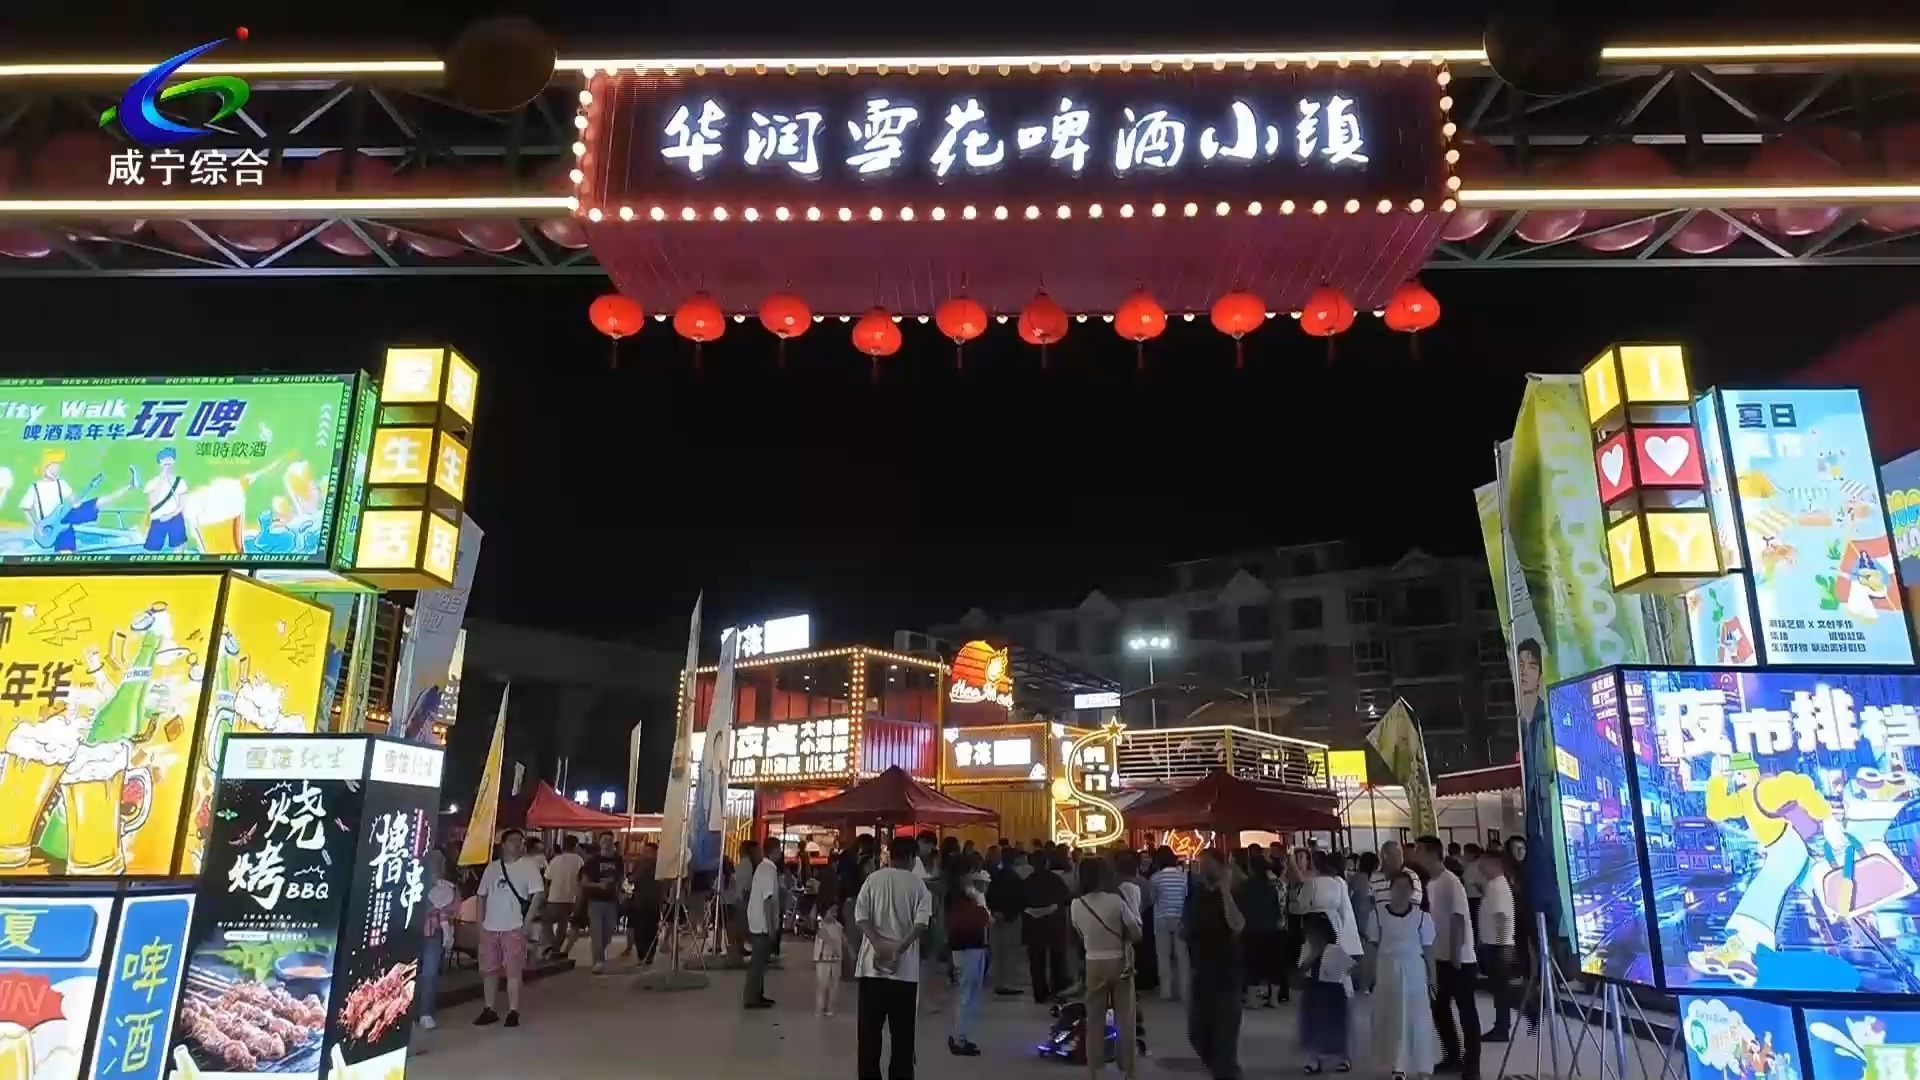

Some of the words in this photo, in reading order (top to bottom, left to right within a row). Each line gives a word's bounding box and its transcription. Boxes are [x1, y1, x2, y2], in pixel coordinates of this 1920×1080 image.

[660, 98, 1370, 182] 华润雪花啤酒小镇
[61, 398, 128, 418] Walk
[126, 399, 248, 439] 玩啤
[23, 423, 125, 441] 啤酒嘉年华
[195, 440, 267, 458] 準時飲酒
[228, 780, 327, 910] 烧烤
[285, 882, 329, 899] BBQ
[102, 936, 173, 1075] 啤酒
